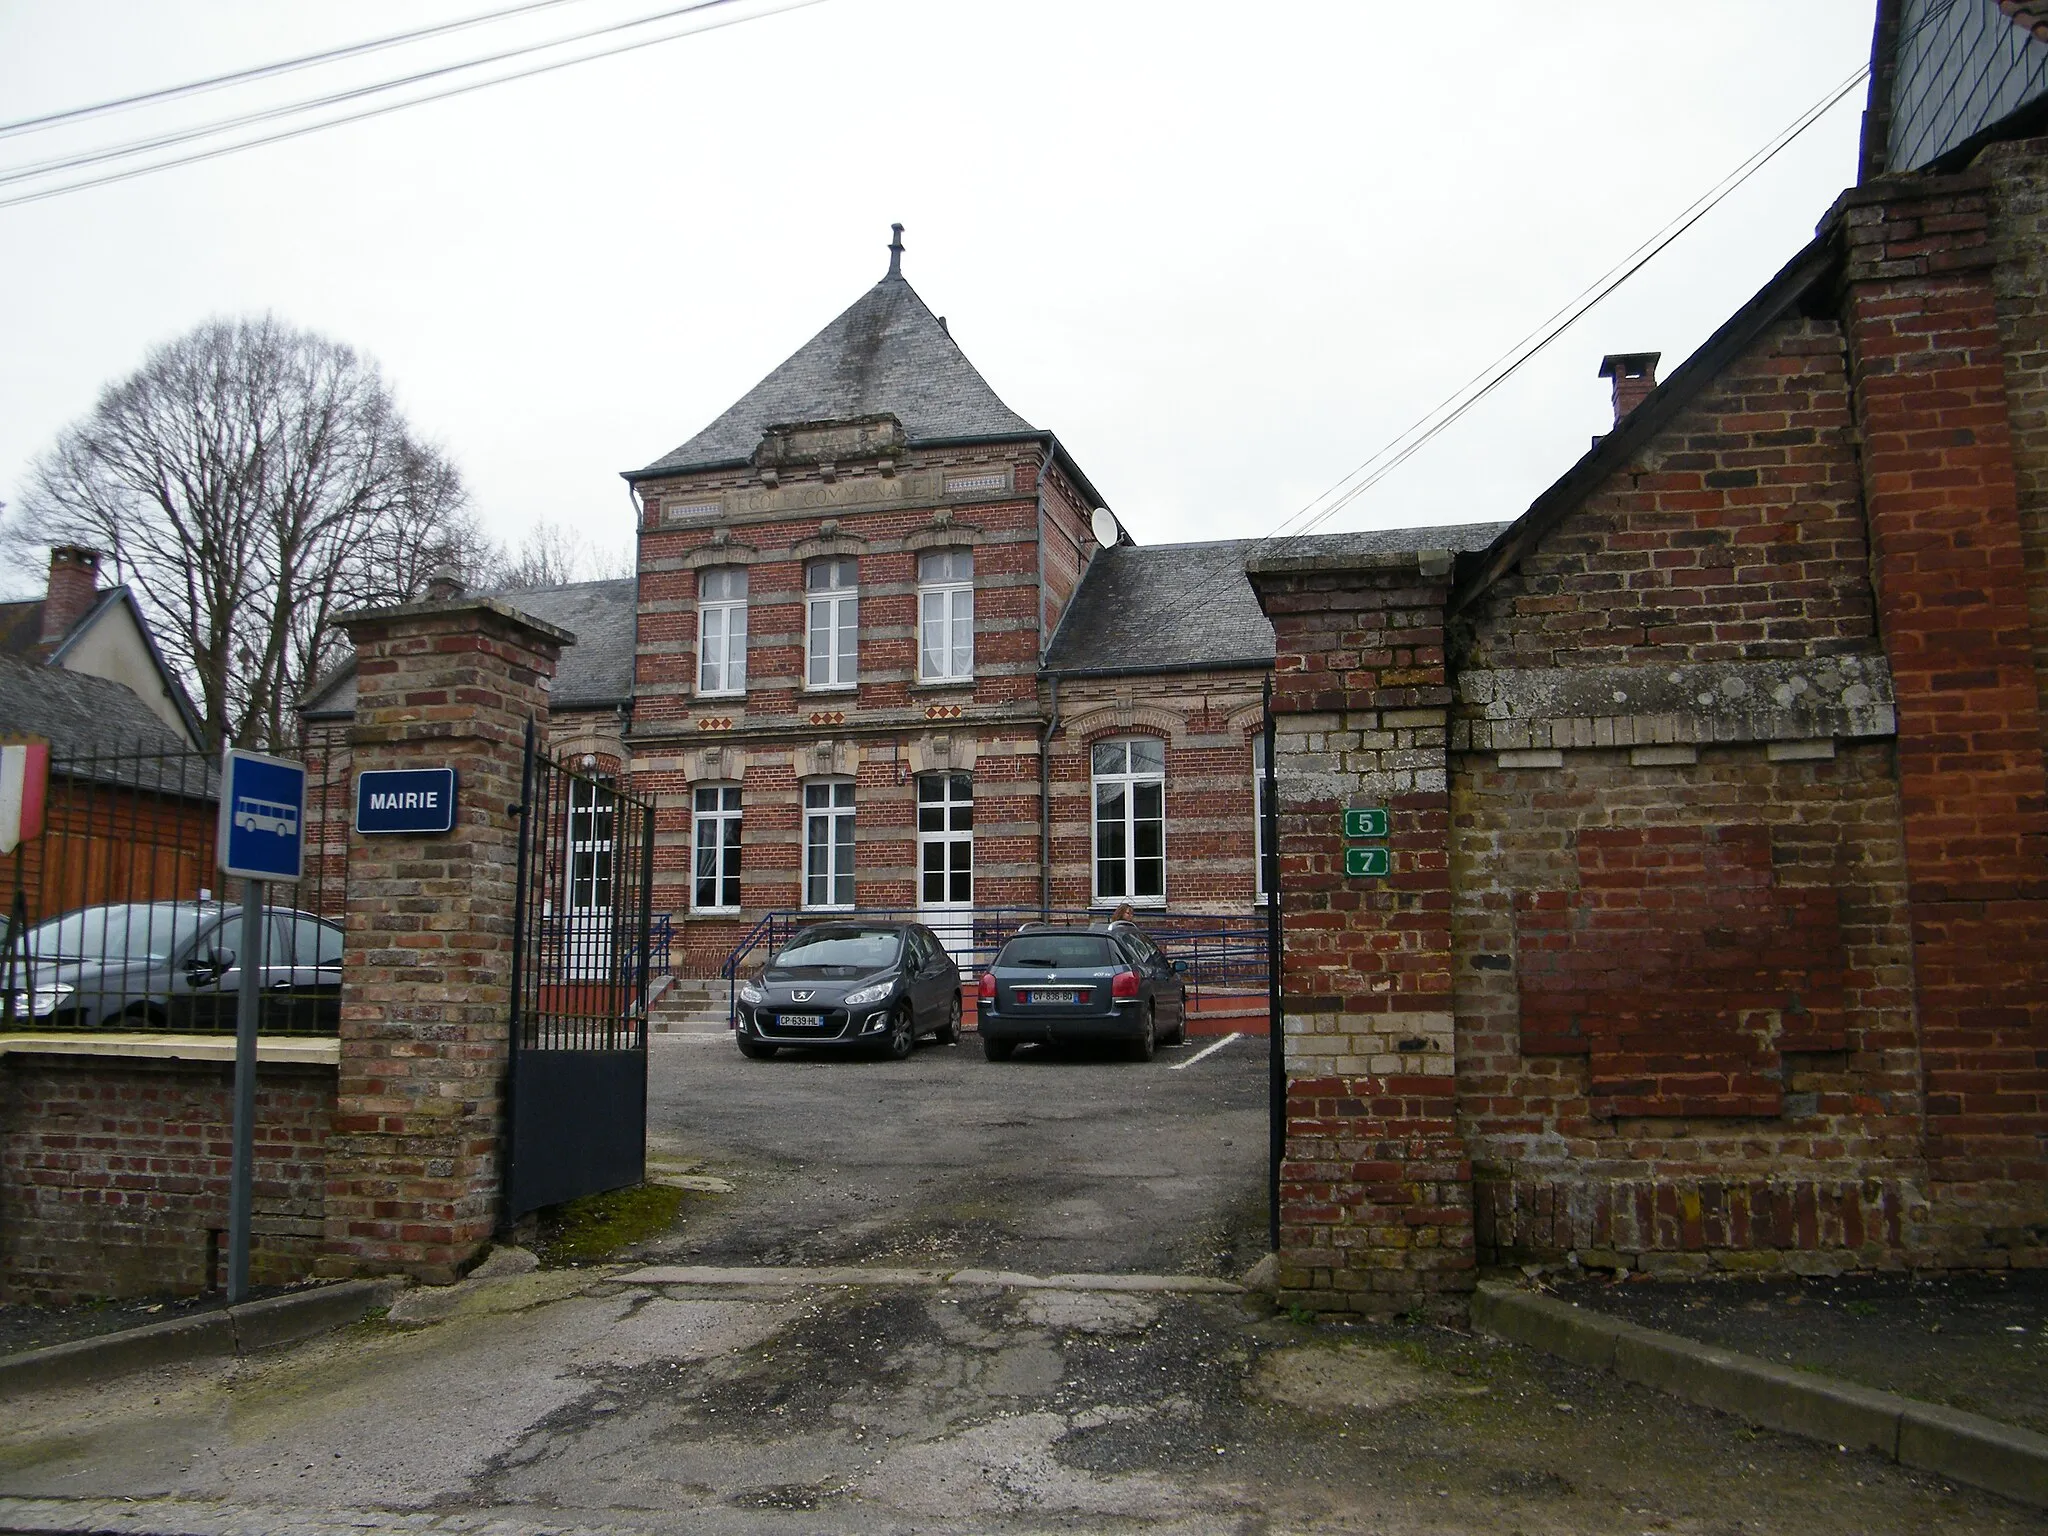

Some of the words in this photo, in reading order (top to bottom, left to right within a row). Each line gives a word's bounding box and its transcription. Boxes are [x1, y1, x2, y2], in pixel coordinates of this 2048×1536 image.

[370, 791, 438, 809] MAIRIE
[1358, 813, 1374, 833] 5
[1360, 852, 1374, 872] 7
